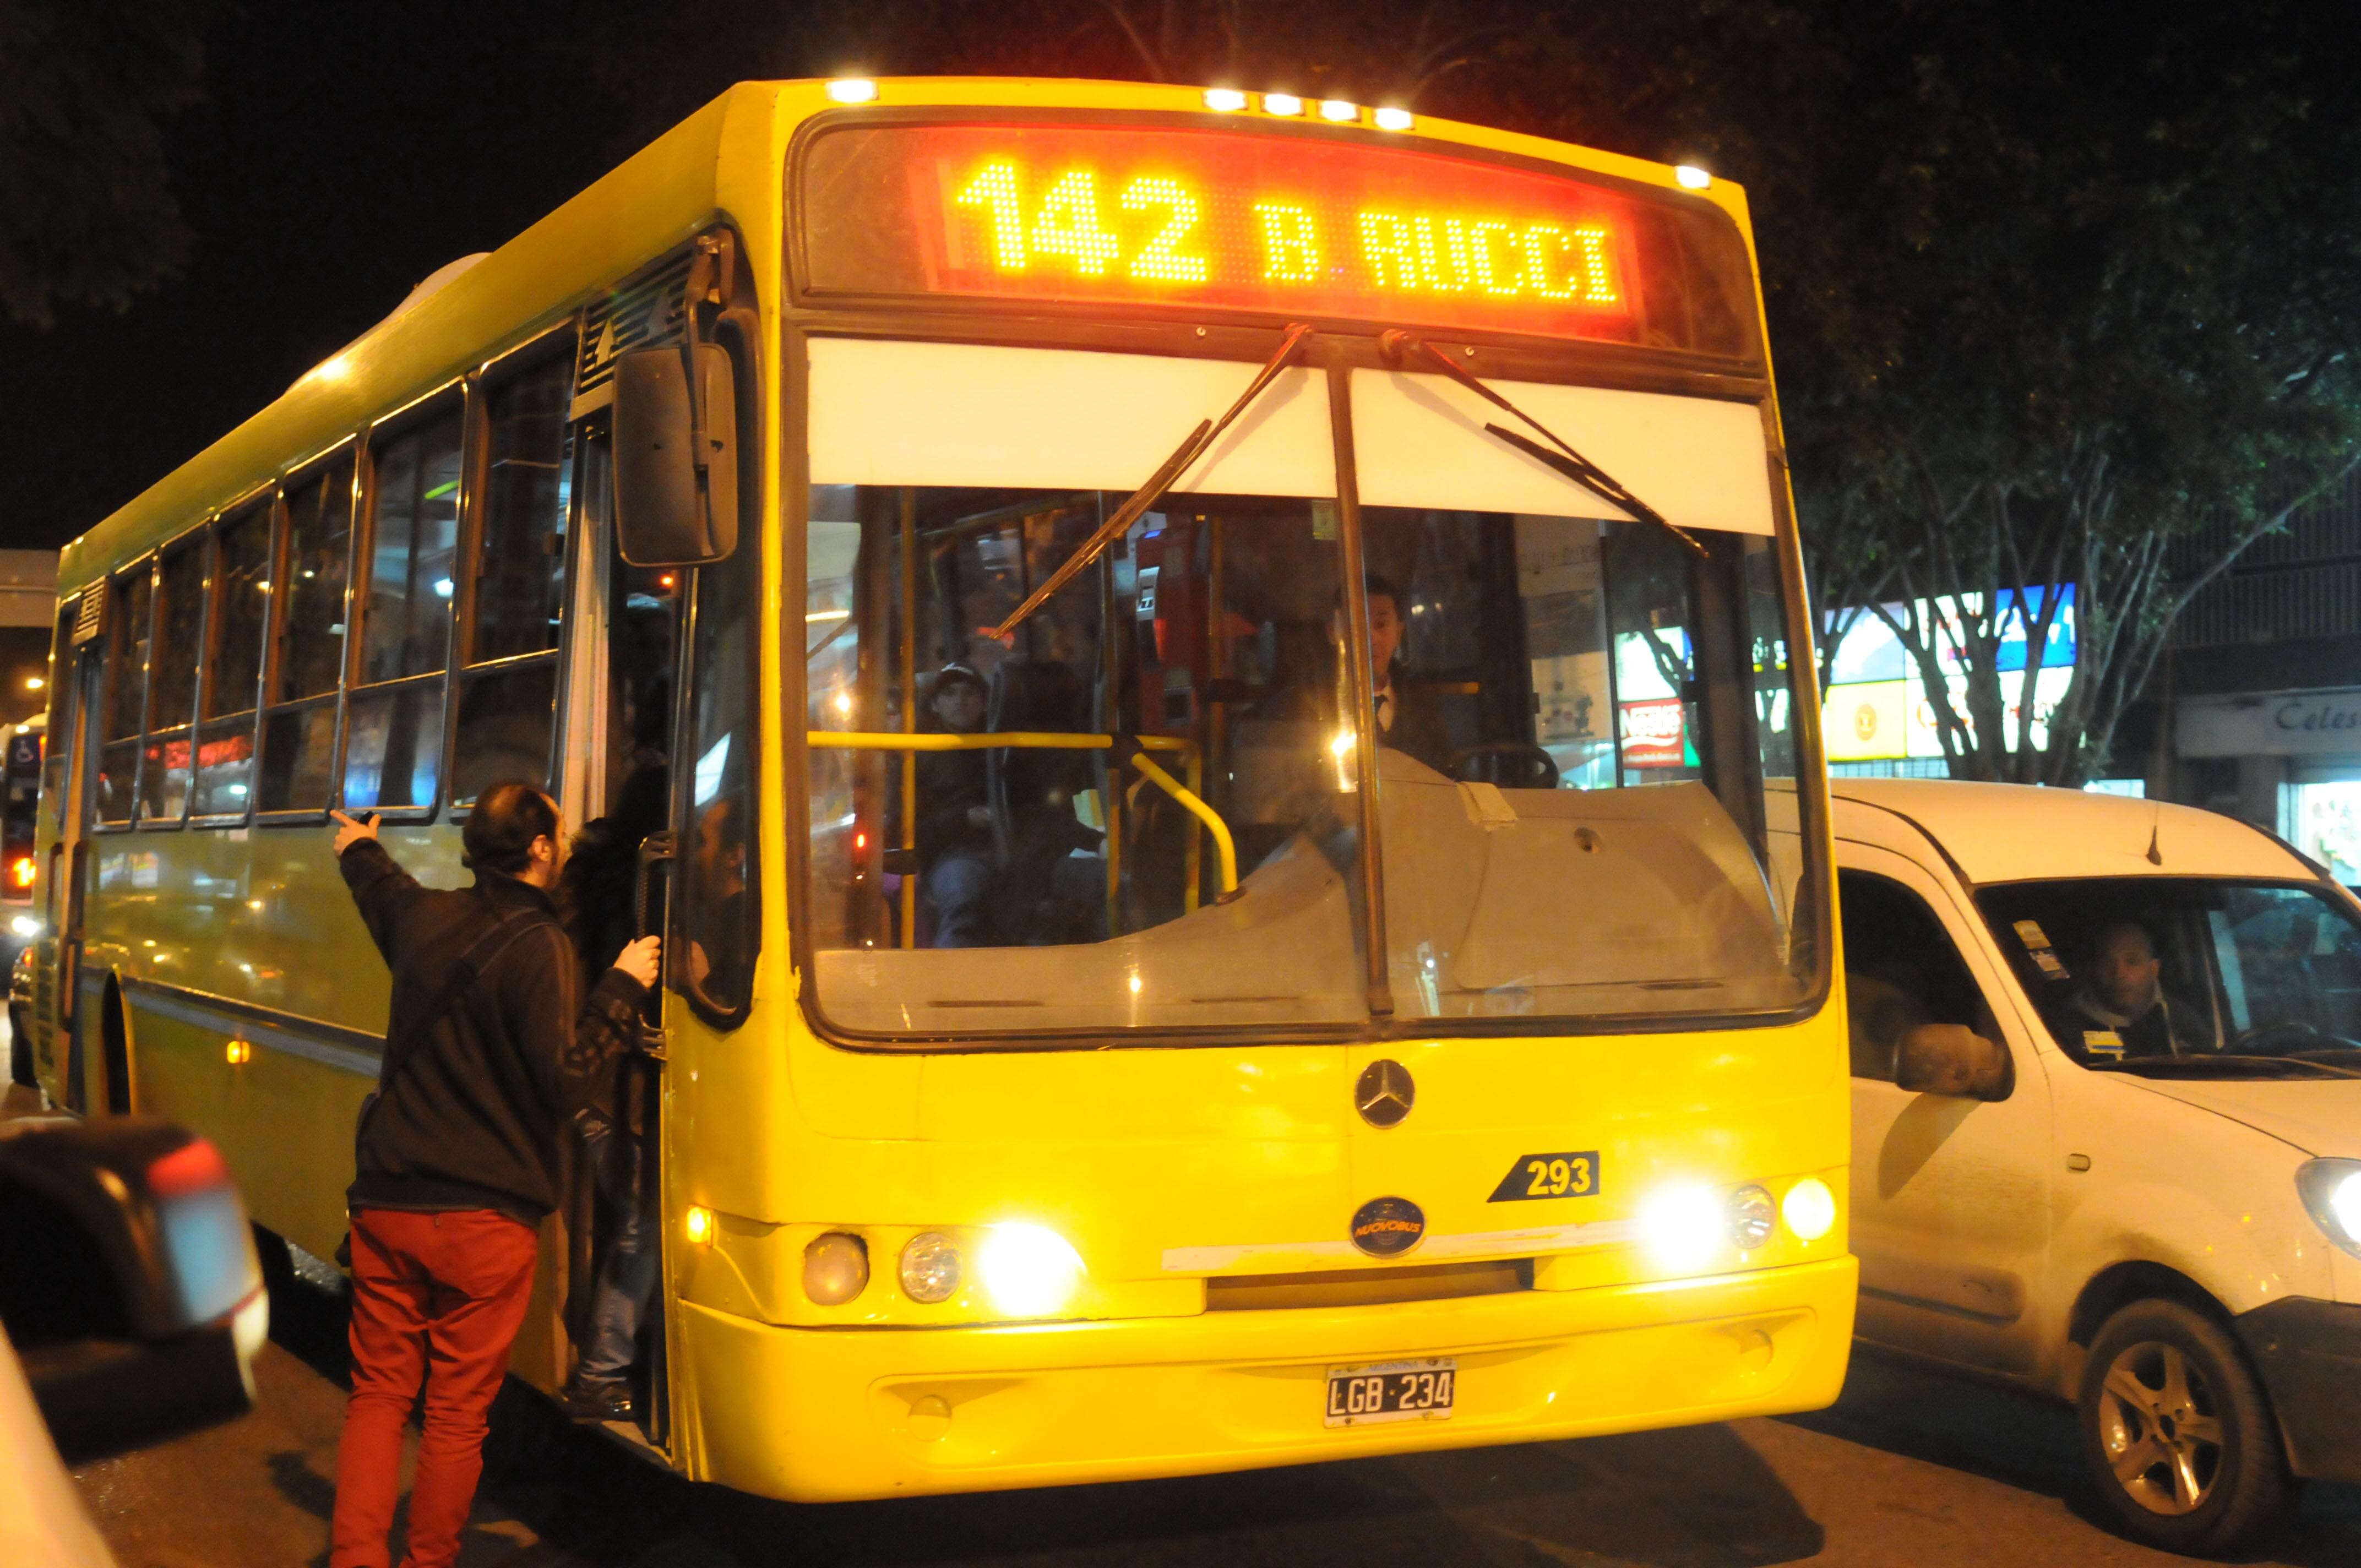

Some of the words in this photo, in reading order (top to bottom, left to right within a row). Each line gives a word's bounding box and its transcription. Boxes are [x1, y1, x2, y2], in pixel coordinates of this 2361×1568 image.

[957, 164, 1207, 281] 142
[1255, 204, 1319, 281] B
[1359, 212, 1617, 301] RUCCI
[2276, 700, 2361, 731] Celes
[1526, 1157, 1591, 1195] 293
[1354, 1219, 1421, 1238] NUOVOBUS
[1329, 1377, 1384, 1415] LGB
[1399, 1372, 1451, 1409] 234
